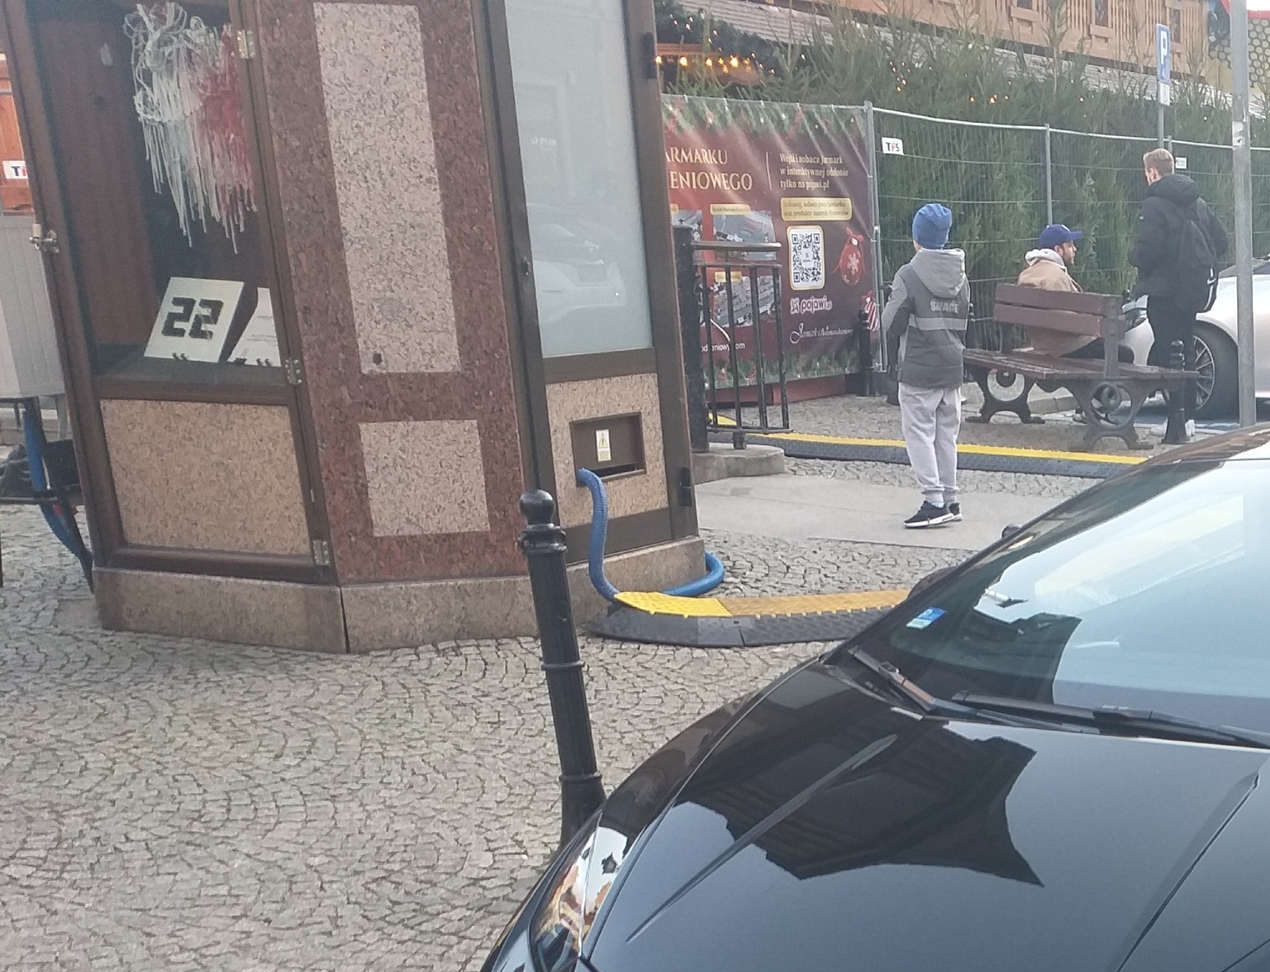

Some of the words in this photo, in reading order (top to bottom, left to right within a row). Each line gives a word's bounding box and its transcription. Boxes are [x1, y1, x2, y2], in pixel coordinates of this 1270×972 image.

[1160, 30, 1168, 65] P
[666, 147, 728, 165] RMARKU
[886, 142, 900, 152] TFS
[780, 180, 796, 190] tylko
[161, 297, 224, 340] 22
